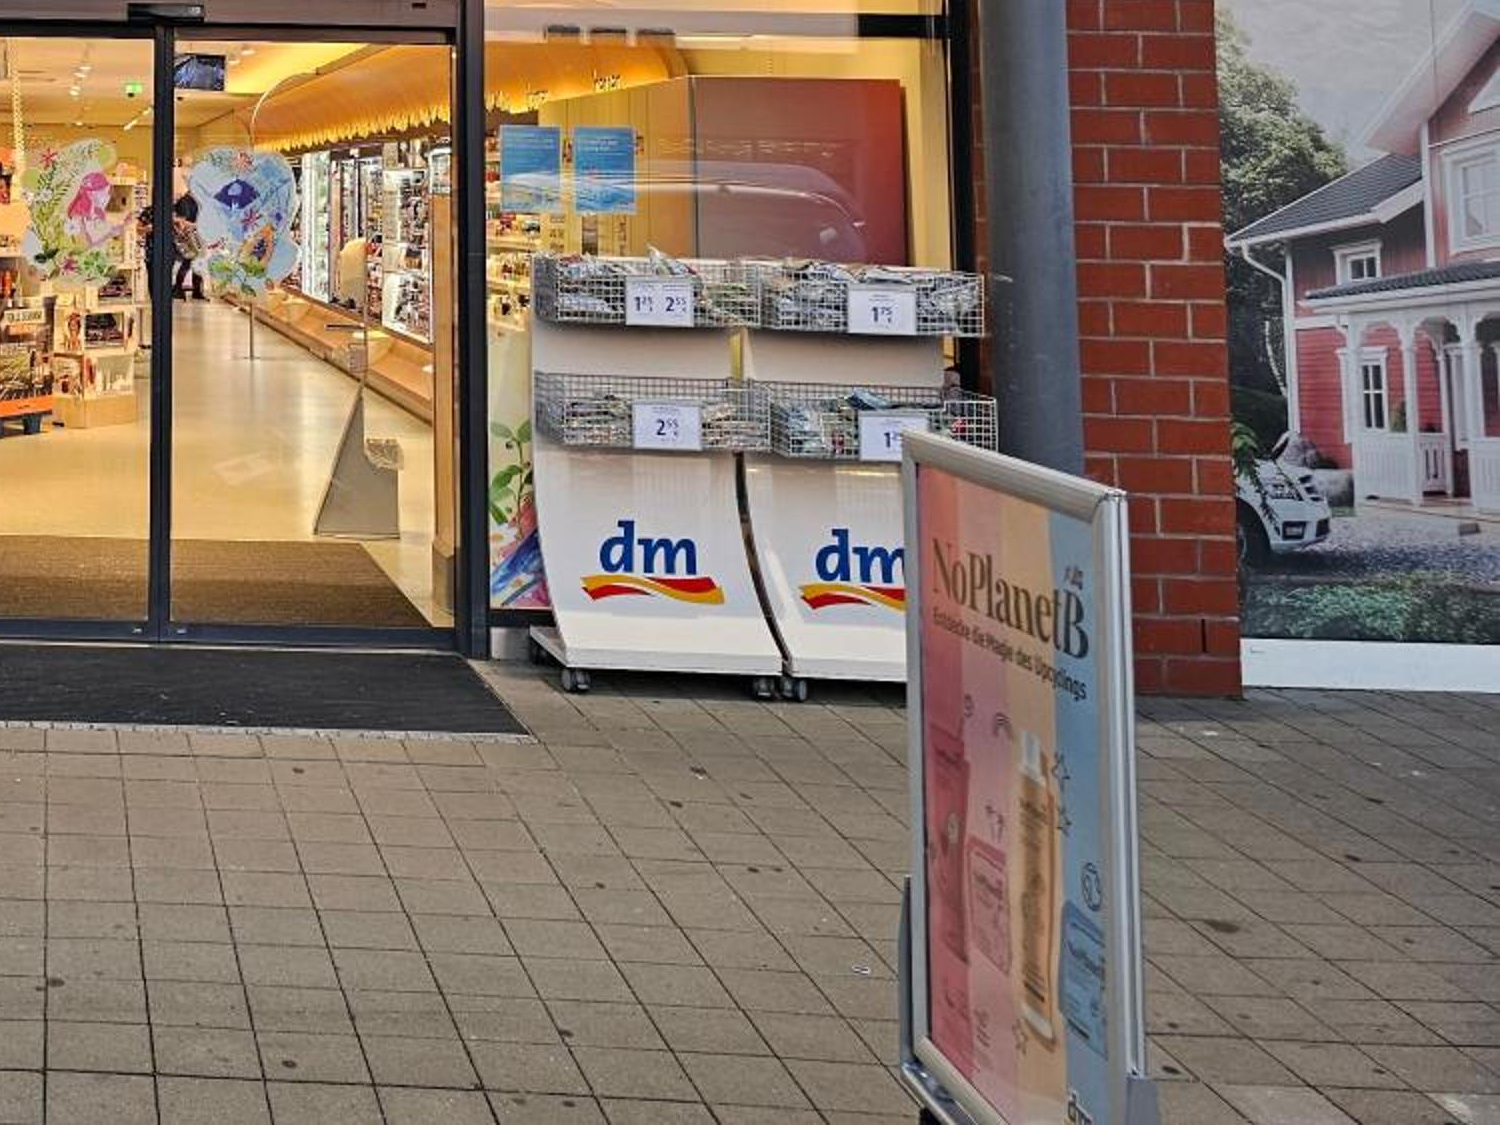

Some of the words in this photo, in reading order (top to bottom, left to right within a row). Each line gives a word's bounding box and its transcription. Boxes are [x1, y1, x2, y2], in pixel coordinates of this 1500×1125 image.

[599, 520, 698, 576] dm
[815, 528, 905, 584] dm
[931, 537, 1090, 660] NoPlanetB
